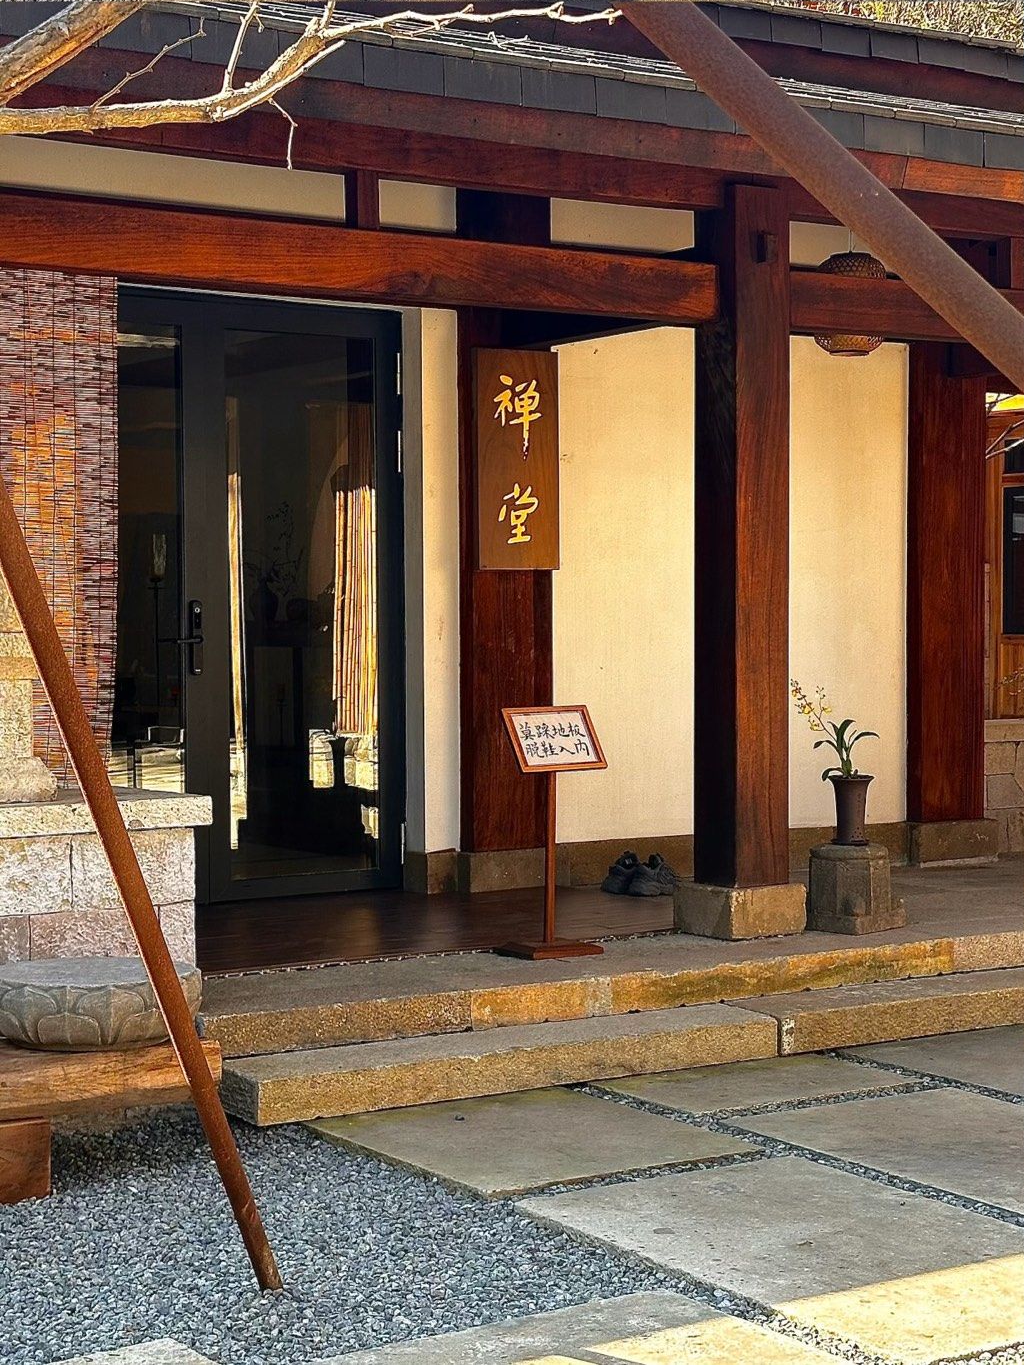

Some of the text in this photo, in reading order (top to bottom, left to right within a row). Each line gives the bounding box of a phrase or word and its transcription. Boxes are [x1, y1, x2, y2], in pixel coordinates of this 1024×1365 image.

[493, 373, 543, 546] 禅堂
[518, 720, 587, 742] 莫踩地板
[525, 738, 591, 759] 脱鞋入内
